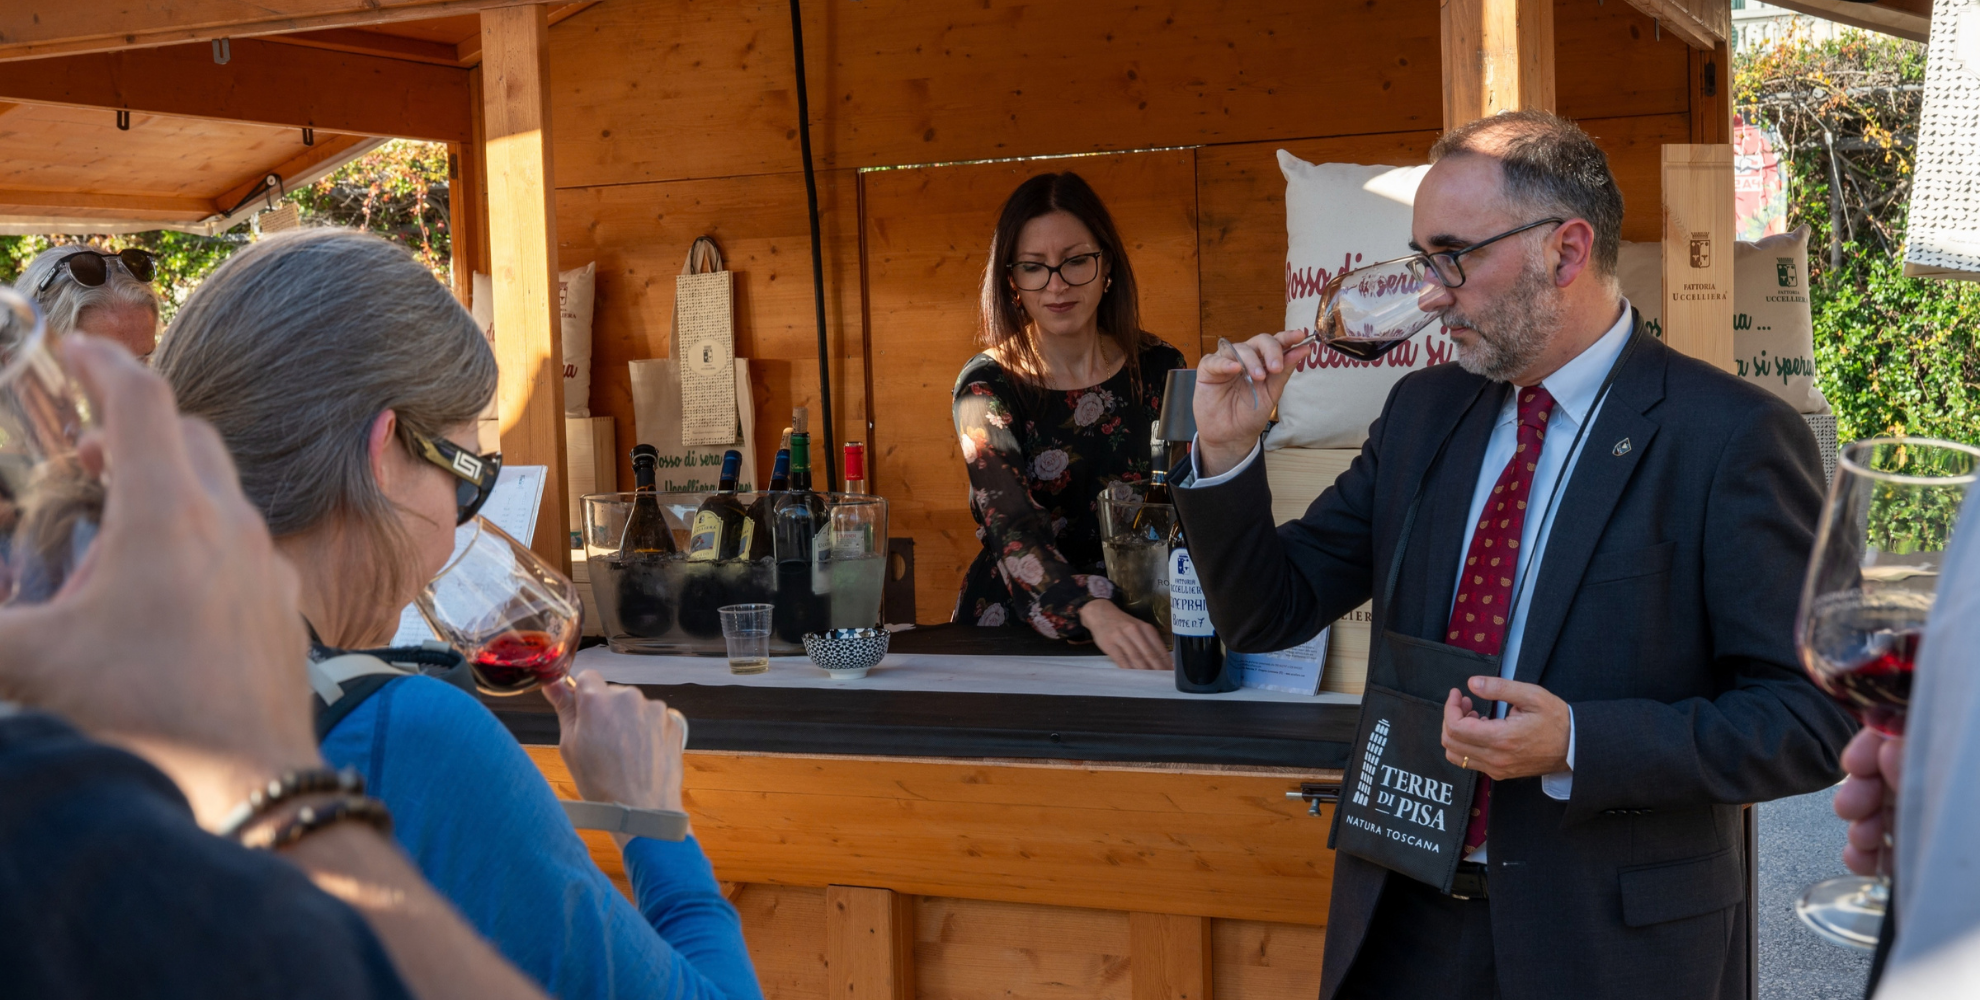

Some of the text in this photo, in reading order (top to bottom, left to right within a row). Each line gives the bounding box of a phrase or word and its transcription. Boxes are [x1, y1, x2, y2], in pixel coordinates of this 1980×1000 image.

[1672, 292, 1727, 301] UCCELLIERA
[1683, 283, 1716, 291] FATTORIA
[1753, 349, 1771, 377] si
[657, 449, 723, 469] osso di sera
[1380, 764, 1453, 805] TERRE
[1376, 790, 1447, 832] DI PISA
[1346, 815, 1440, 853] NATURA TOSCANA
